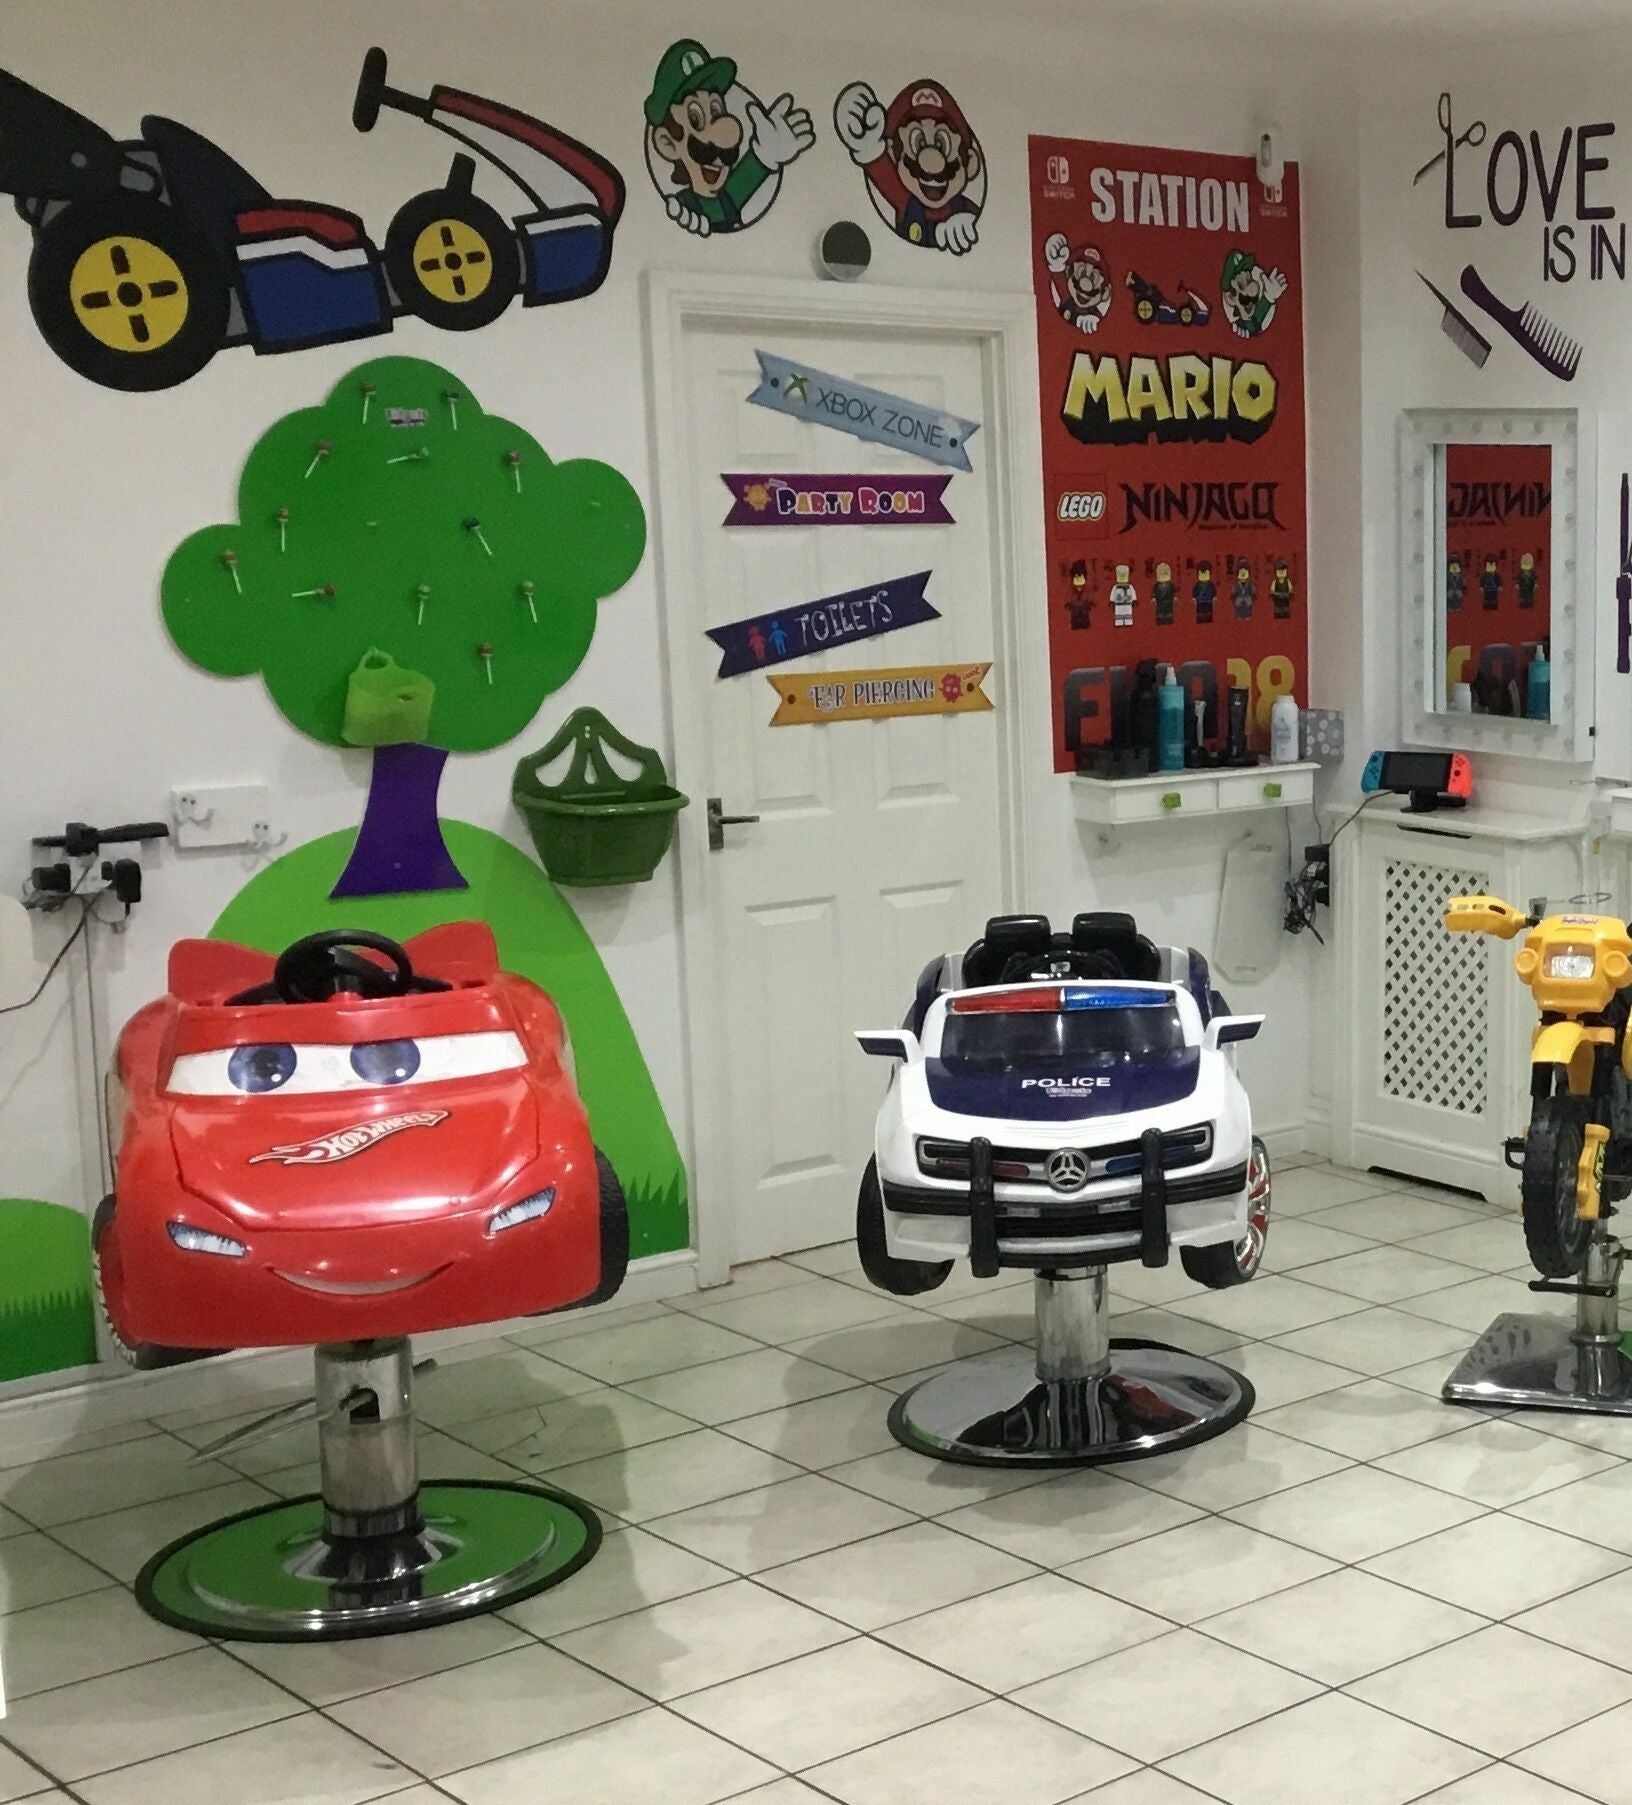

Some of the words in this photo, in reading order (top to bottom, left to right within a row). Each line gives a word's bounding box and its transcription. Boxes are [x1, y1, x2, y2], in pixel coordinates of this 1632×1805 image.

[1089, 166, 1250, 233] STATION
[1445, 122, 1616, 228] LOVE
[1543, 224, 1577, 283] IS
[1590, 222, 1626, 281] IN
[816, 388, 877, 426] XBOX
[881, 409, 944, 448] ZONE
[1061, 350, 1278, 432] MARIO
[776, 487, 854, 515] PARTY
[858, 487, 925, 515] ROOM
[1057, 492, 1106, 521] LEGO
[1117, 482, 1288, 534] NINJAGO
[795, 590, 894, 646] TOILETS
[853, 678, 935, 707] PIERCING
[1021, 1076, 1111, 1089] POLICE
